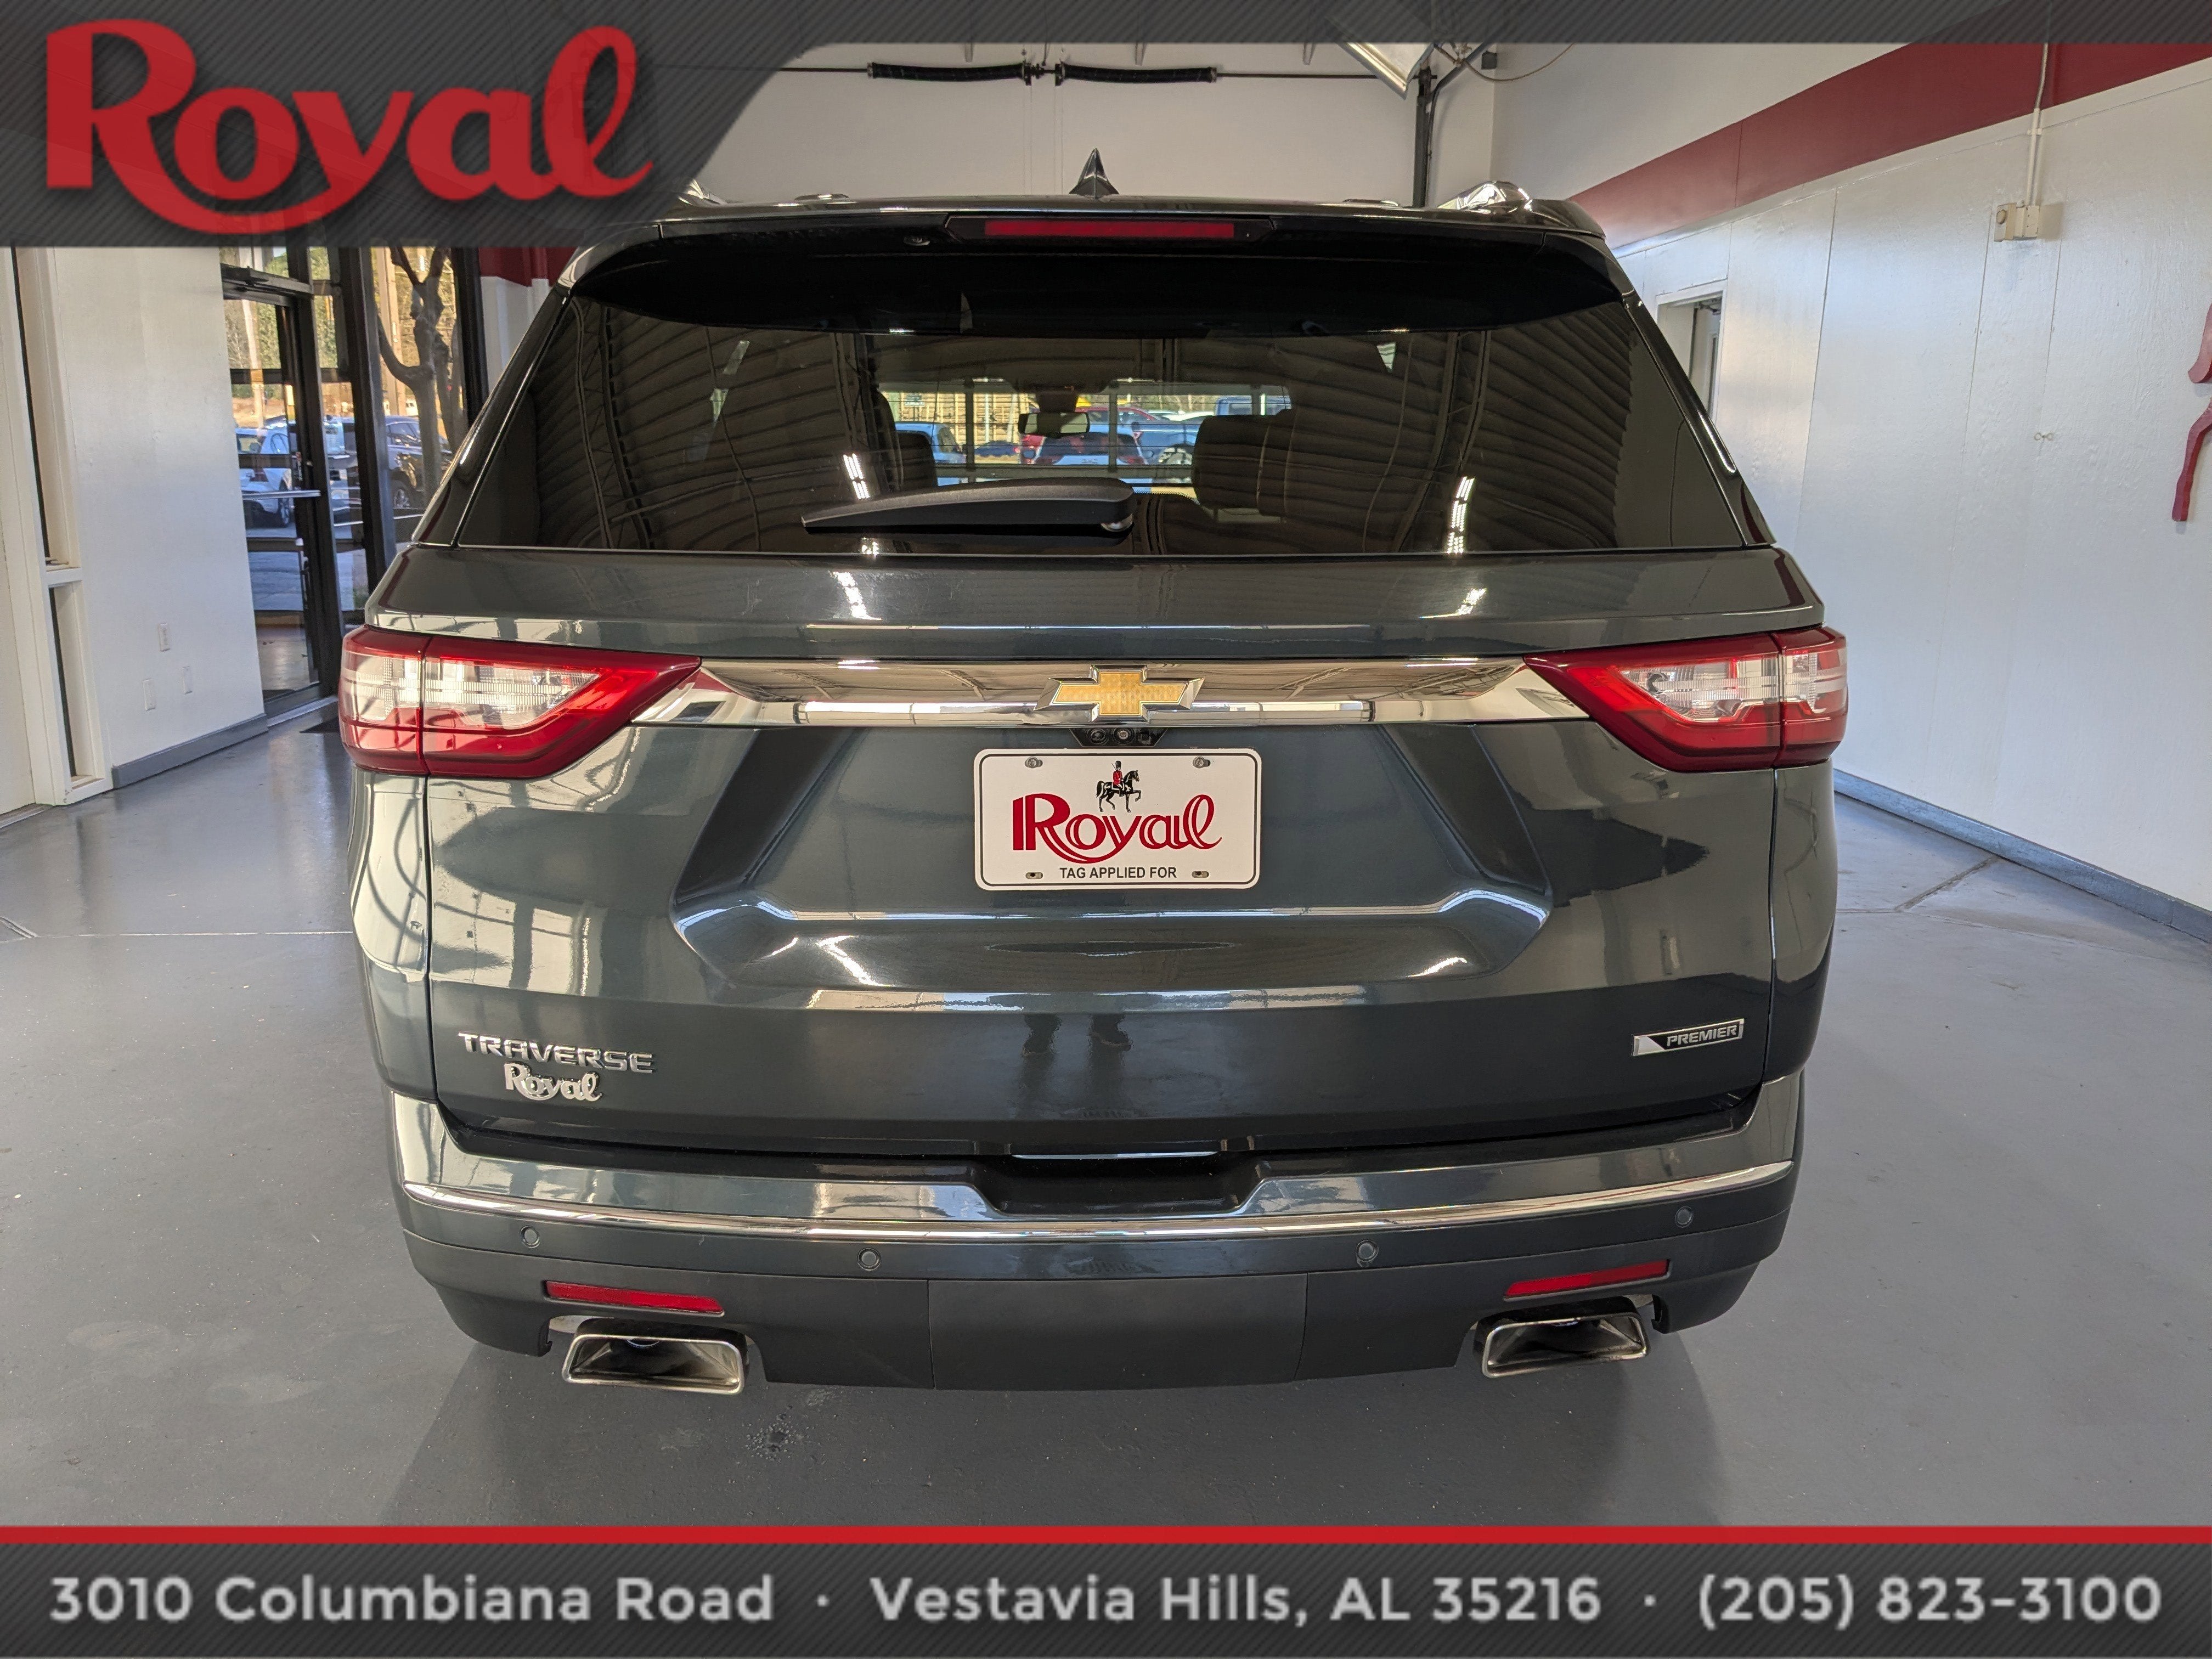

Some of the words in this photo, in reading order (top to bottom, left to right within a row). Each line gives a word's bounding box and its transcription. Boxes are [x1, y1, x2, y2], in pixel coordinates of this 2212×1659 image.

[1013, 793, 1222, 864] Royal
[1059, 867, 1086, 879] TAG
[1089, 867, 1146, 878] APPLIED
[1150, 866, 1177, 878] FOR
[458, 1031, 655, 1074] TRAVERSE
[1666, 1025, 1737, 1047] PREMIER
[504, 1060, 603, 1102] Royal
